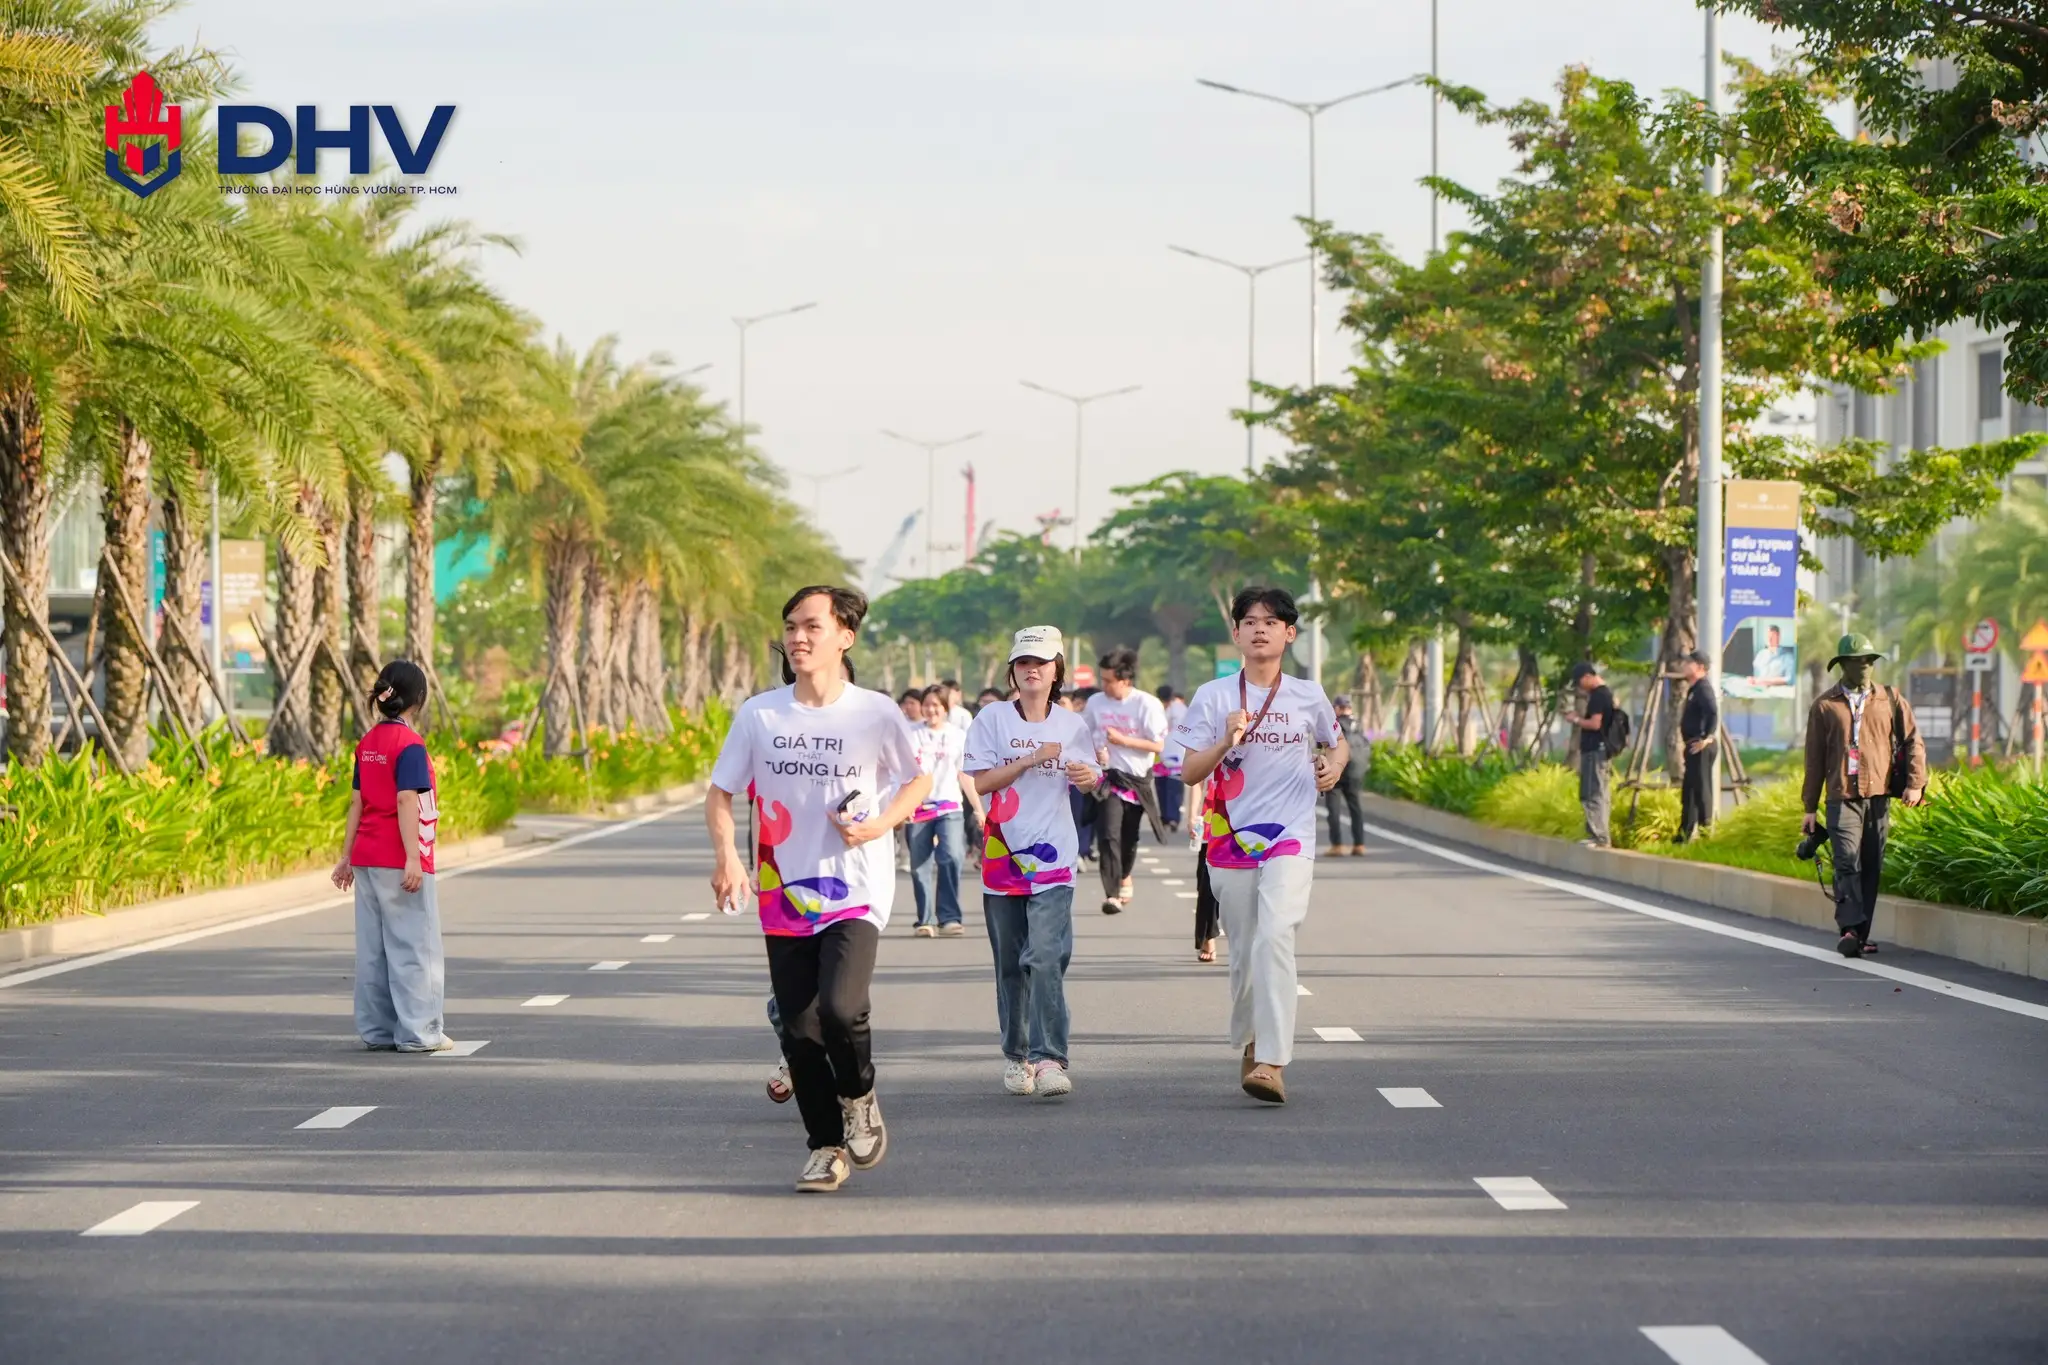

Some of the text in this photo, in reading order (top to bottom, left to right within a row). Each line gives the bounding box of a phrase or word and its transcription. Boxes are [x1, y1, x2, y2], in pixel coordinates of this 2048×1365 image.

[1265, 712, 1289, 725] TRỊ
[773, 733, 843, 755] GIÁ TRỊ
[1010, 738, 1036, 749] GIÁ
[1283, 733, 1304, 743] LAI
[834, 764, 862, 778] LAI
